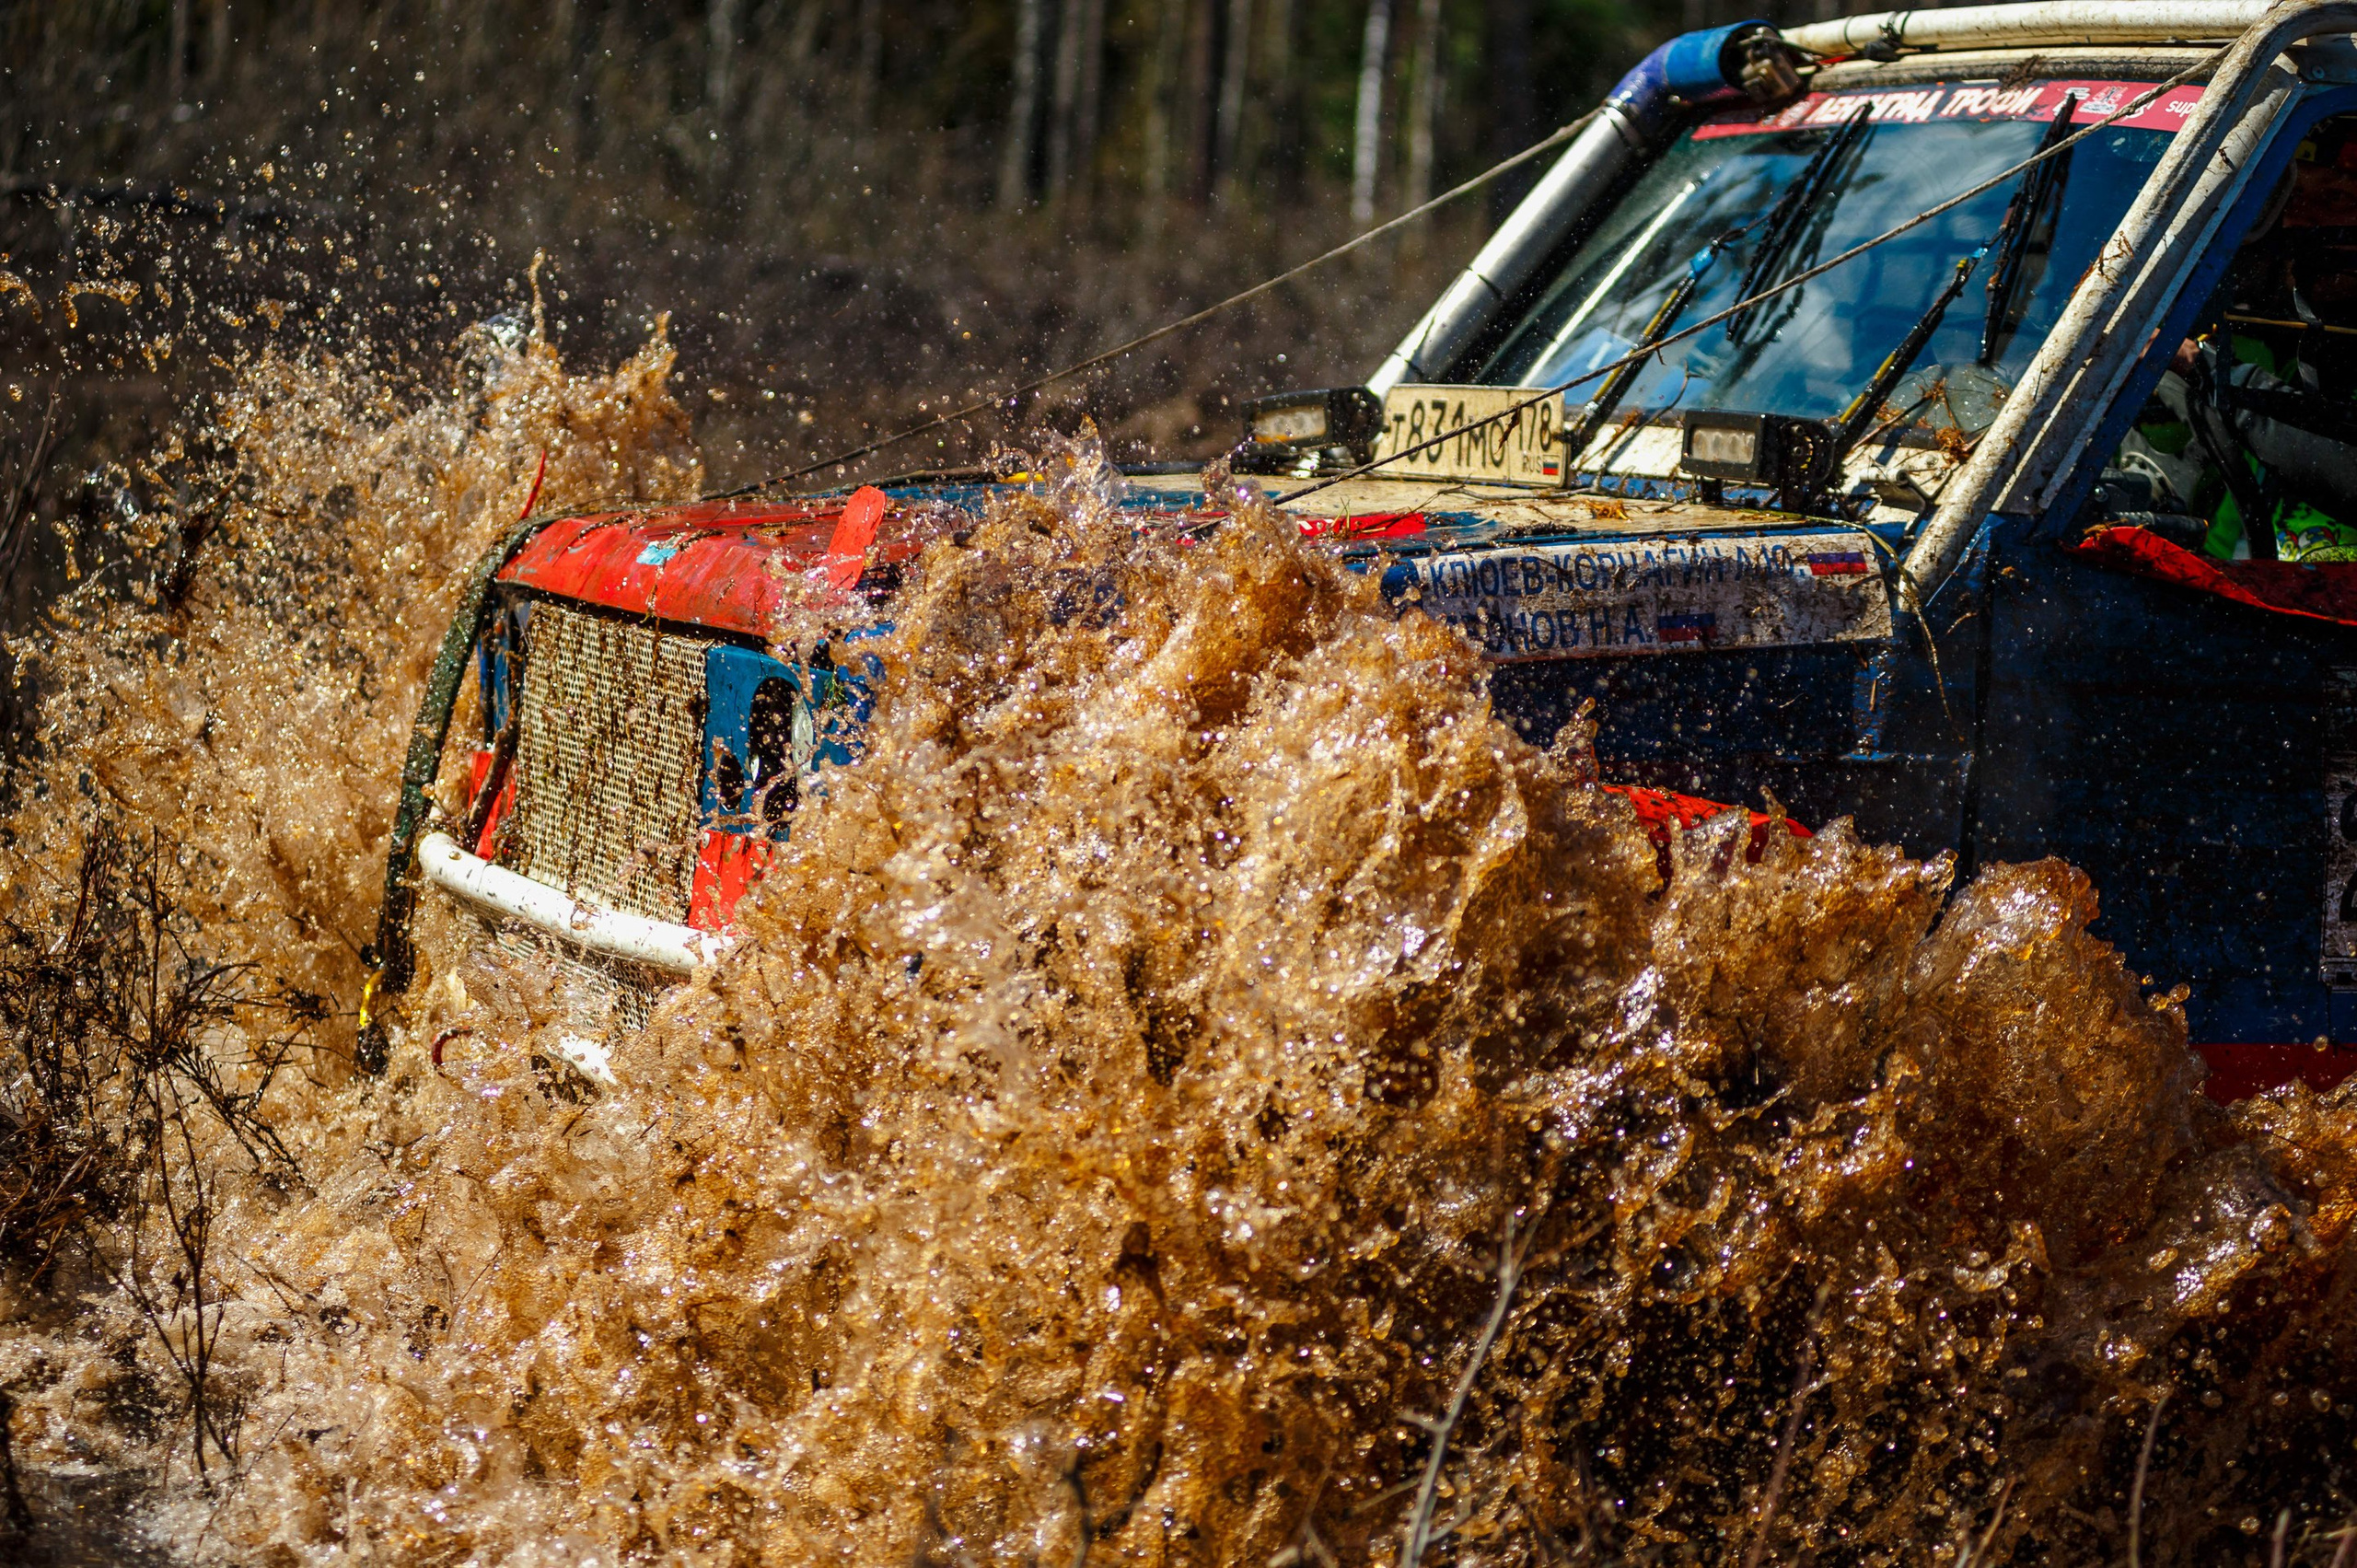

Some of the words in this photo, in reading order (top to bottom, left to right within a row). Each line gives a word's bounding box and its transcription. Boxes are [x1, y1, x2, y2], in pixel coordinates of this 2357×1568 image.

[1939, 87, 2044, 116] ТРОФИ
[2165, 100, 2197, 116] sup
[1516, 400, 1552, 451] 178
[1522, 454, 1543, 473] RUS
